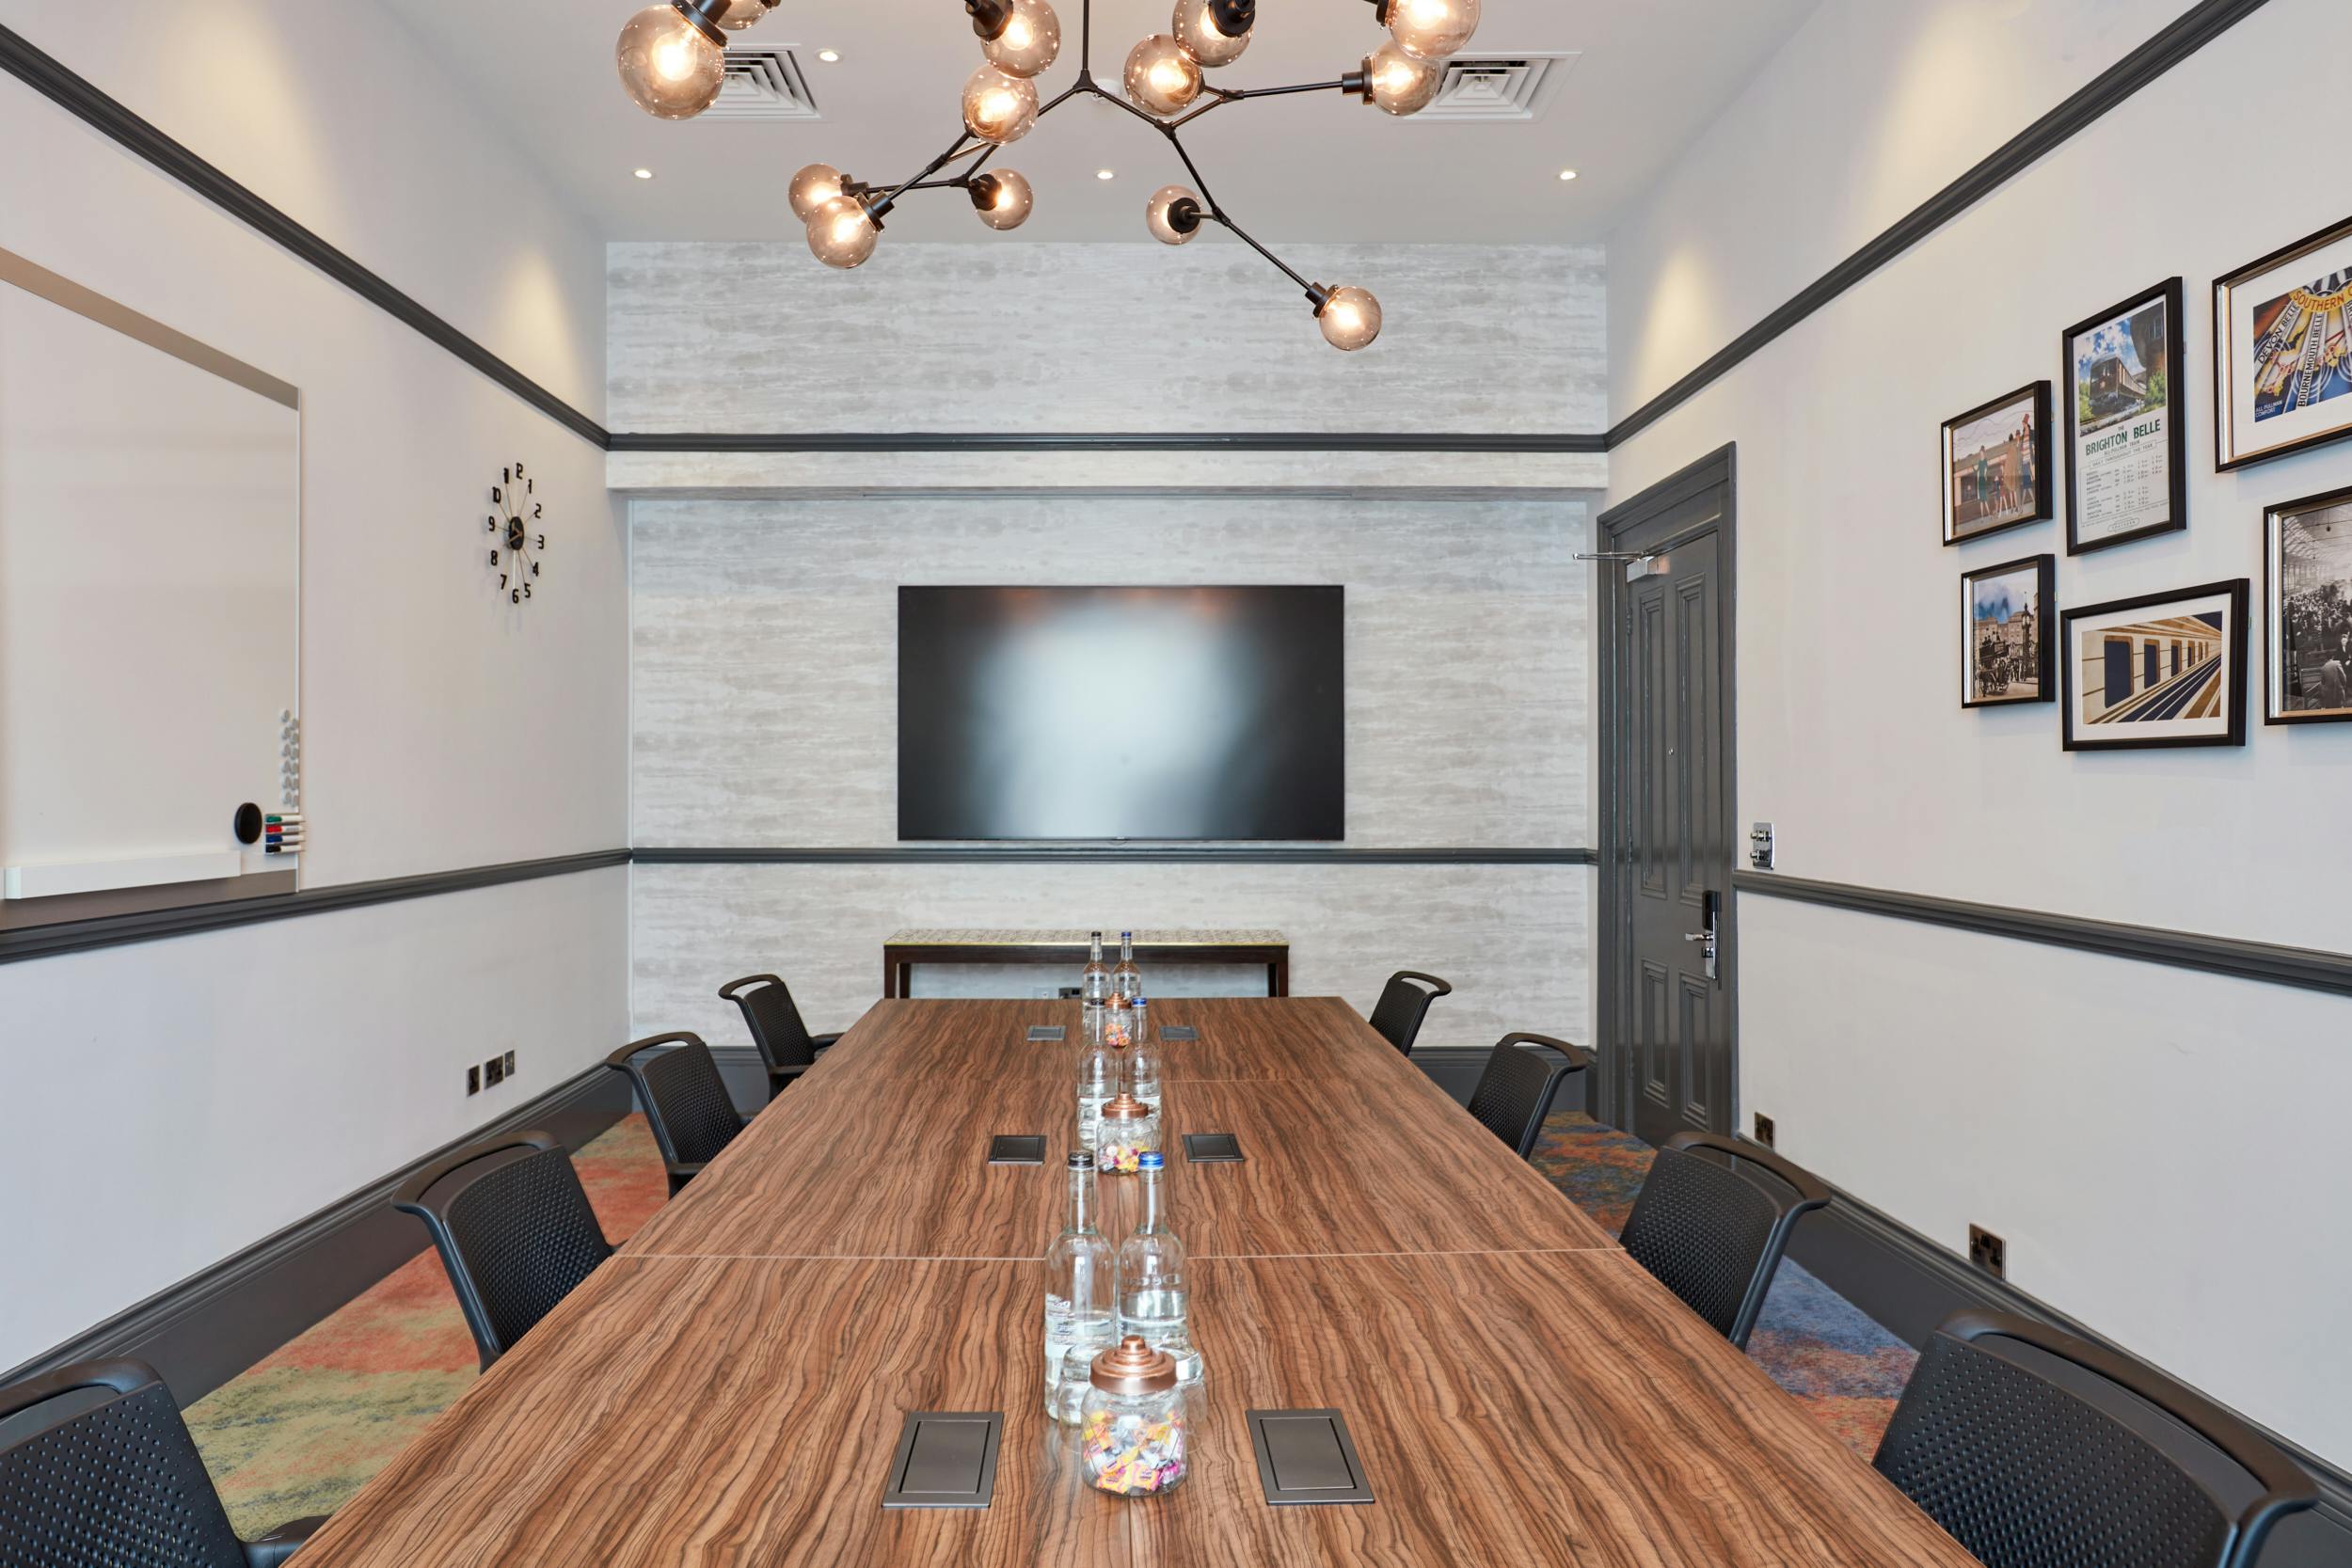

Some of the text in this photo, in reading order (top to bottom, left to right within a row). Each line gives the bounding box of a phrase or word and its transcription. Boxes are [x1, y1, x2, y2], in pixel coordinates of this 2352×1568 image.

[2293, 290, 2344, 311] SOUTHERN
[2258, 302, 2297, 365] DEVON BELLE
[2297, 313, 2324, 406] BOURNEMOUTH BELLE
[2086, 419, 2161, 455] BRIGHTON BELLE
[492, 486, 501, 503] 10
[528, 479, 532, 494] 1
[534, 503, 542, 518] 2
[488, 515, 496, 531] 9
[538, 534, 545, 549] 3
[490, 549, 498, 565] 8
[532, 562, 539, 577] 4
[500, 574, 507, 590] 7
[512, 589, 519, 604] 6
[524, 583, 531, 598] 5
